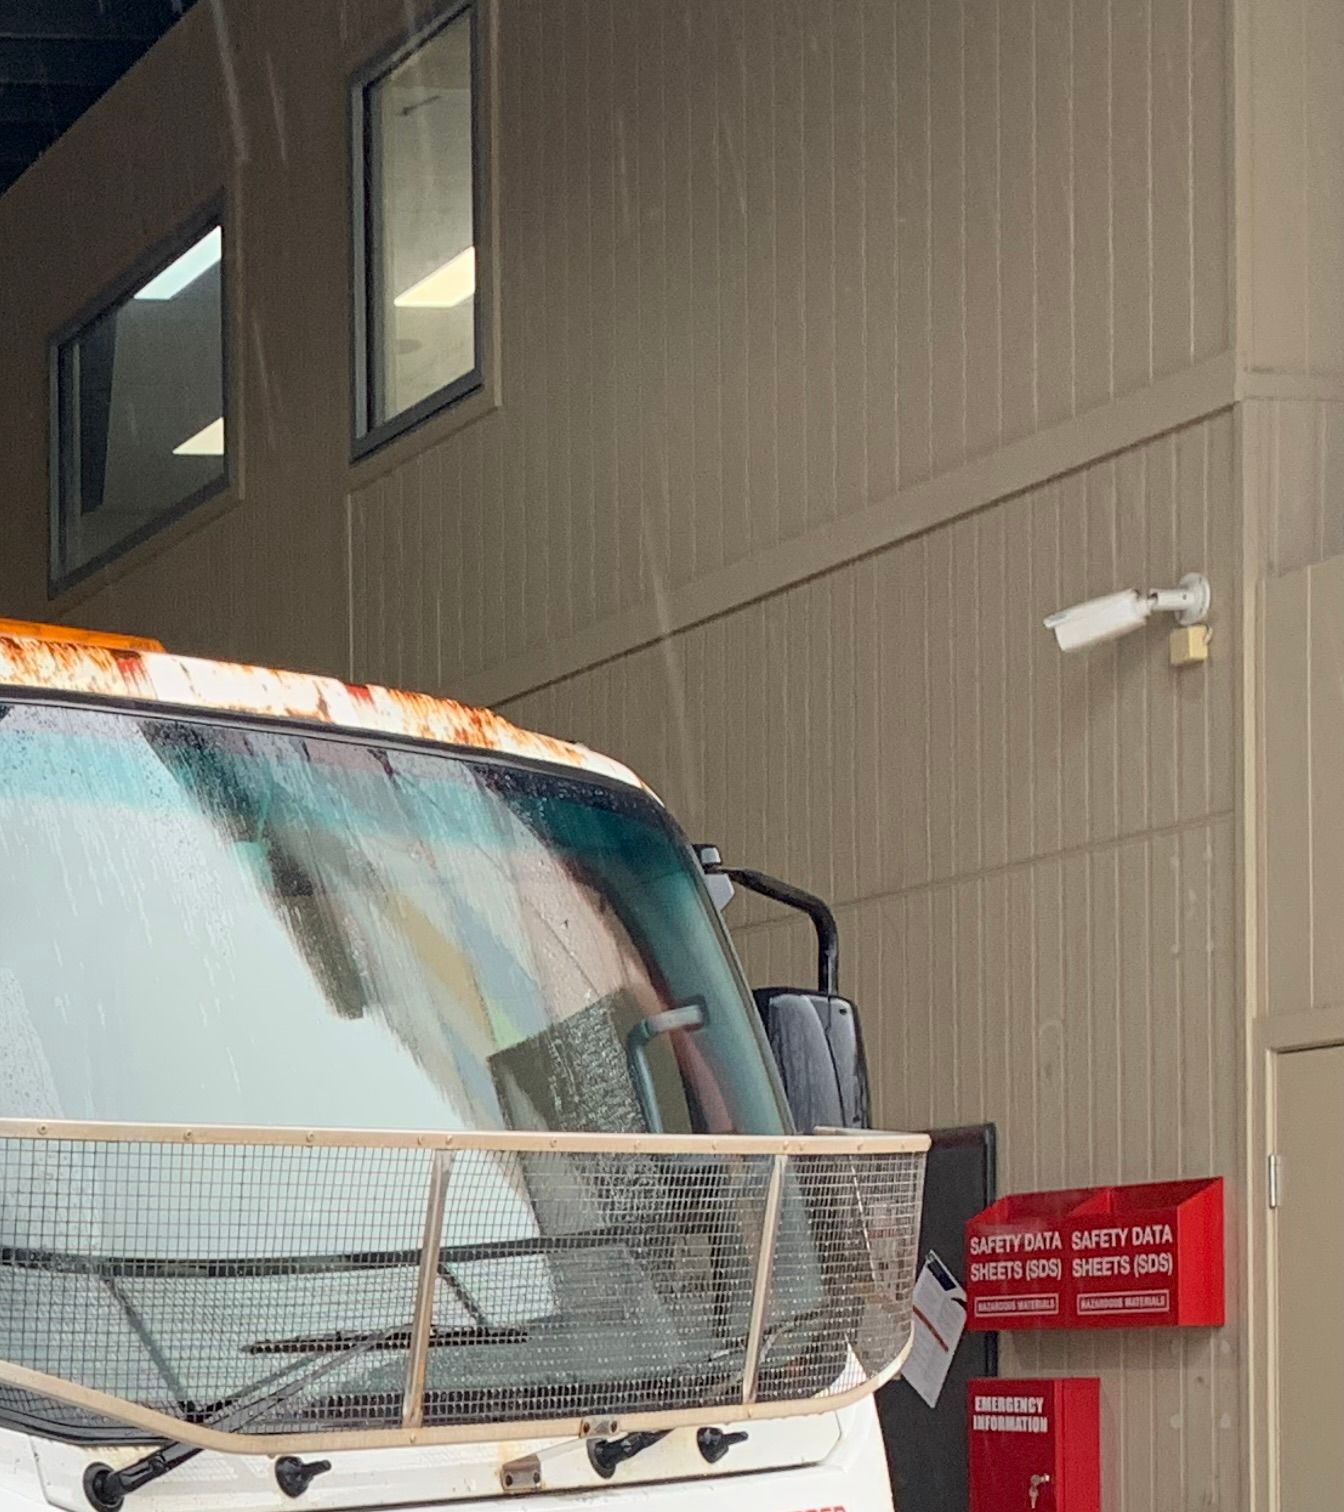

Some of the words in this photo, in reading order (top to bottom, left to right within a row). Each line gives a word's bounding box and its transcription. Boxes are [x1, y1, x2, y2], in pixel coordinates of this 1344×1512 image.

[970, 1234, 1021, 1255] SAFETY
[1024, 1231, 1062, 1250] DATA
[1071, 1228, 1128, 1250] SAFETY
[1132, 1225, 1173, 1246] DATA
[970, 1260, 1023, 1281] SHEETS
[1025, 1258, 1062, 1281] (SDS)
[1072, 1256, 1130, 1277] SHEETS
[1133, 1253, 1173, 1277] (SDS)
[974, 1396, 1044, 1414] EMERGENCY
[973, 1414, 1048, 1433] INFORMATION
